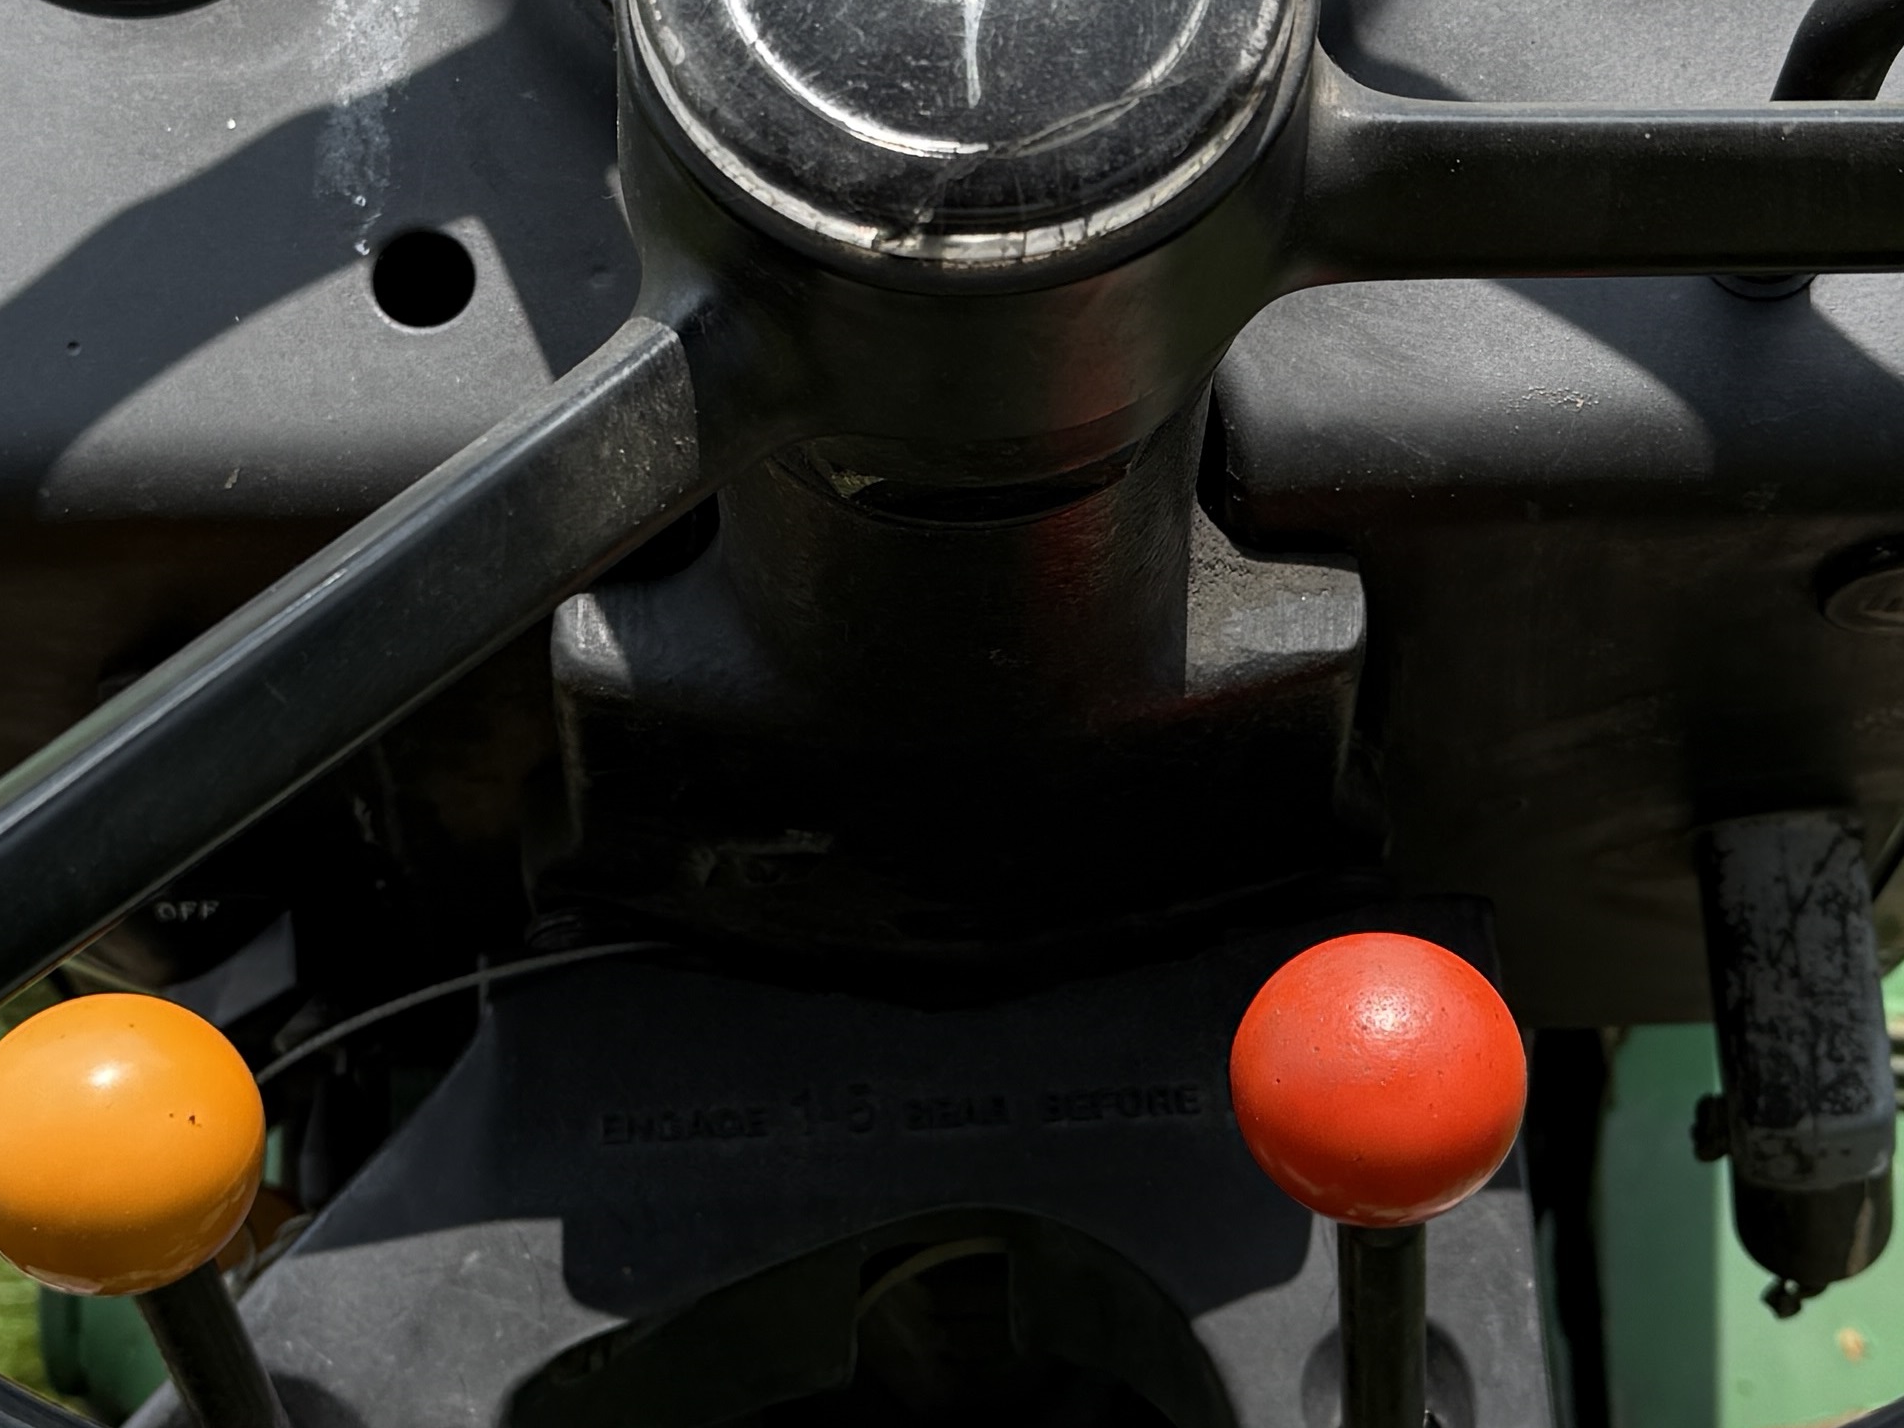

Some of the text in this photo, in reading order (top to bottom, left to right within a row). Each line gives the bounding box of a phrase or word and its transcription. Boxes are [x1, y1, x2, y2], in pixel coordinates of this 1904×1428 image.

[153, 899, 221, 923] OFF
[602, 1107, 770, 1145] ENGAGE
[1041, 1083, 1203, 1123] BEFORE
